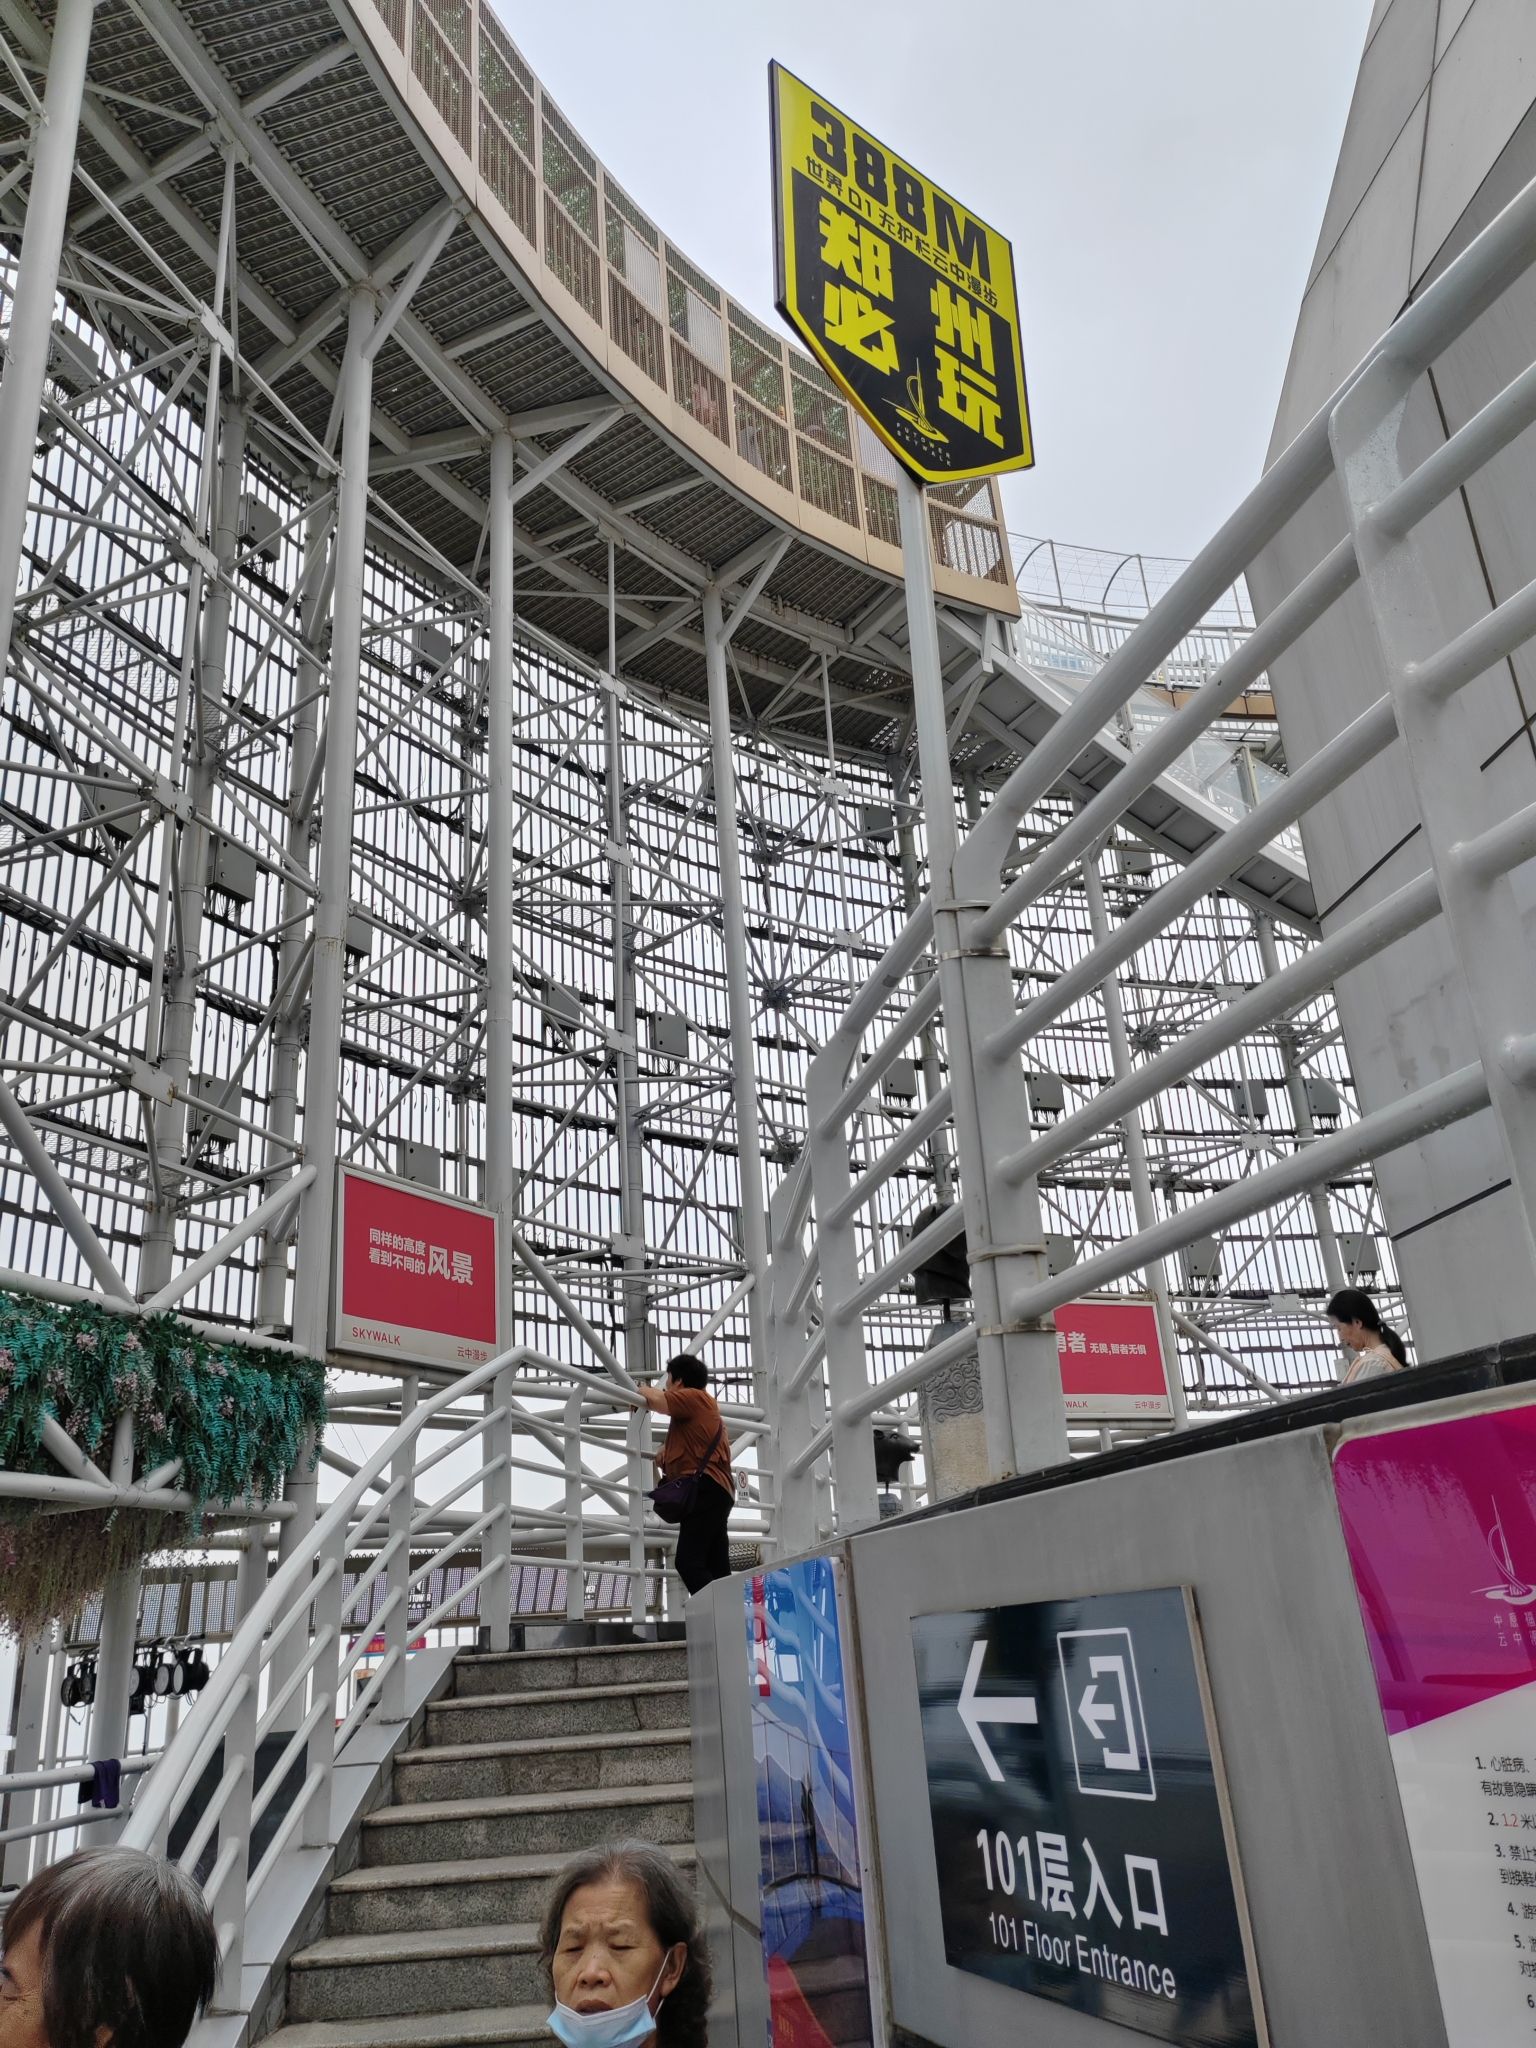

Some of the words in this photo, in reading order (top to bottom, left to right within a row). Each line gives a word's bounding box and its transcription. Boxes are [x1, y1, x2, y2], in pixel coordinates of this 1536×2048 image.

[811, 101, 991, 284] 388M
[369, 1228, 426, 1256] 同样的高度
[369, 1247, 426, 1275] 看到不同的
[428, 1245, 473, 1285] 风景
[352, 1327, 400, 1346] SKYWALK
[457, 1346, 488, 1361] 云中漫步
[1475, 1756, 1487, 1769] 1.
[1487, 1812, 1499, 1826] 2.
[1494, 1843, 1506, 1858] 3.
[976, 1828, 1168, 1936] 101层入口
[1507, 1902, 1519, 1916] 4.
[1513, 1934, 1526, 1950] 5.
[989, 1911, 1020, 1952] 101
[1023, 1920, 1071, 1968] Floor
[1075, 1934, 1177, 2000] Entrance
